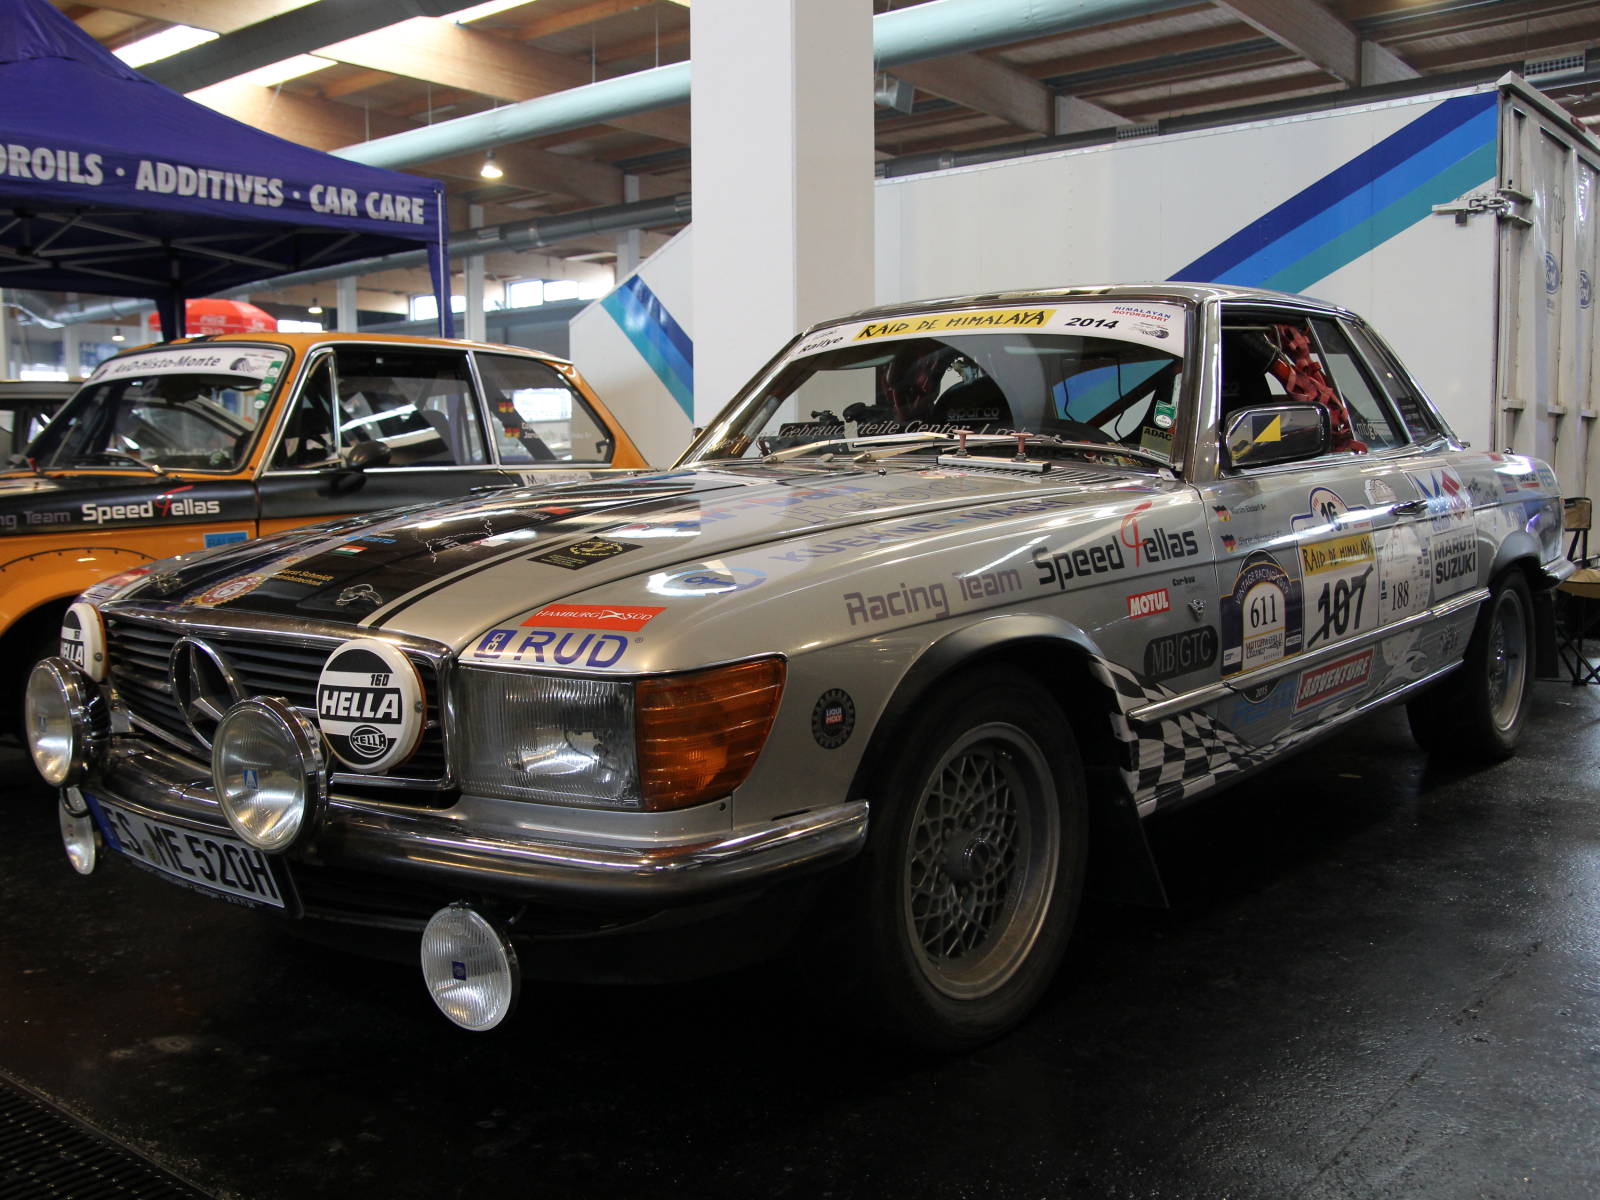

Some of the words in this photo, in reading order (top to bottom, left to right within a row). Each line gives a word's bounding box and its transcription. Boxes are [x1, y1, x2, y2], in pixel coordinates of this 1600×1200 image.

[135, 160, 284, 207] ADDITIVES
[309, 184, 358, 216] CAR
[365, 191, 425, 225] CARE
[1112, 310, 1169, 322] MOTORSPORT
[1115, 306, 1172, 318] HIMALAYAN
[799, 336, 844, 353] Rallye
[858, 323, 909, 338] RAID
[916, 319, 940, 331] DE
[945, 311, 1045, 327] HIMALAYA
[1064, 317, 1120, 329] 2014
[947, 407, 1000, 422] sparco
[1144, 427, 1173, 442] ADAC
[23, 510, 71, 524] Team
[82, 500, 153, 524] Speed
[155, 485, 220, 517] Fellas
[1302, 549, 1326, 572] RAID
[1328, 548, 1338, 566] DE
[1339, 536, 1374, 561] HIMALAYA
[1434, 533, 1476, 560] MARUTI
[844, 583, 949, 626] Racing
[952, 568, 1023, 602] Team
[1032, 535, 1125, 590] Speed
[1121, 500, 1199, 568] Fellas
[1435, 551, 1476, 584] SUZUKI
[1236, 572, 1256, 604] VINTAGE
[1391, 581, 1409, 611] 188
[535, 610, 599, 619] HAMBURG
[626, 611, 652, 620] SÜD
[1130, 590, 1169, 616] MOTUL
[1250, 594, 1277, 628] 611
[1316, 574, 1367, 641] 107
[513, 631, 629, 668] RUD
[1245, 633, 1282, 653] MOTORWORLD
[370, 674, 390, 687] 160
[1255, 685, 1268, 698] 2015
[1301, 655, 1371, 700] ADVENTURE
[321, 690, 399, 719] HELLA
[826, 707, 842, 717] LIQUI
[826, 714, 842, 724] MOLY
[353, 733, 387, 748] HELLA
[103, 806, 144, 857] ES
[144, 822, 196, 877] ME
[183, 833, 279, 900] 520H
